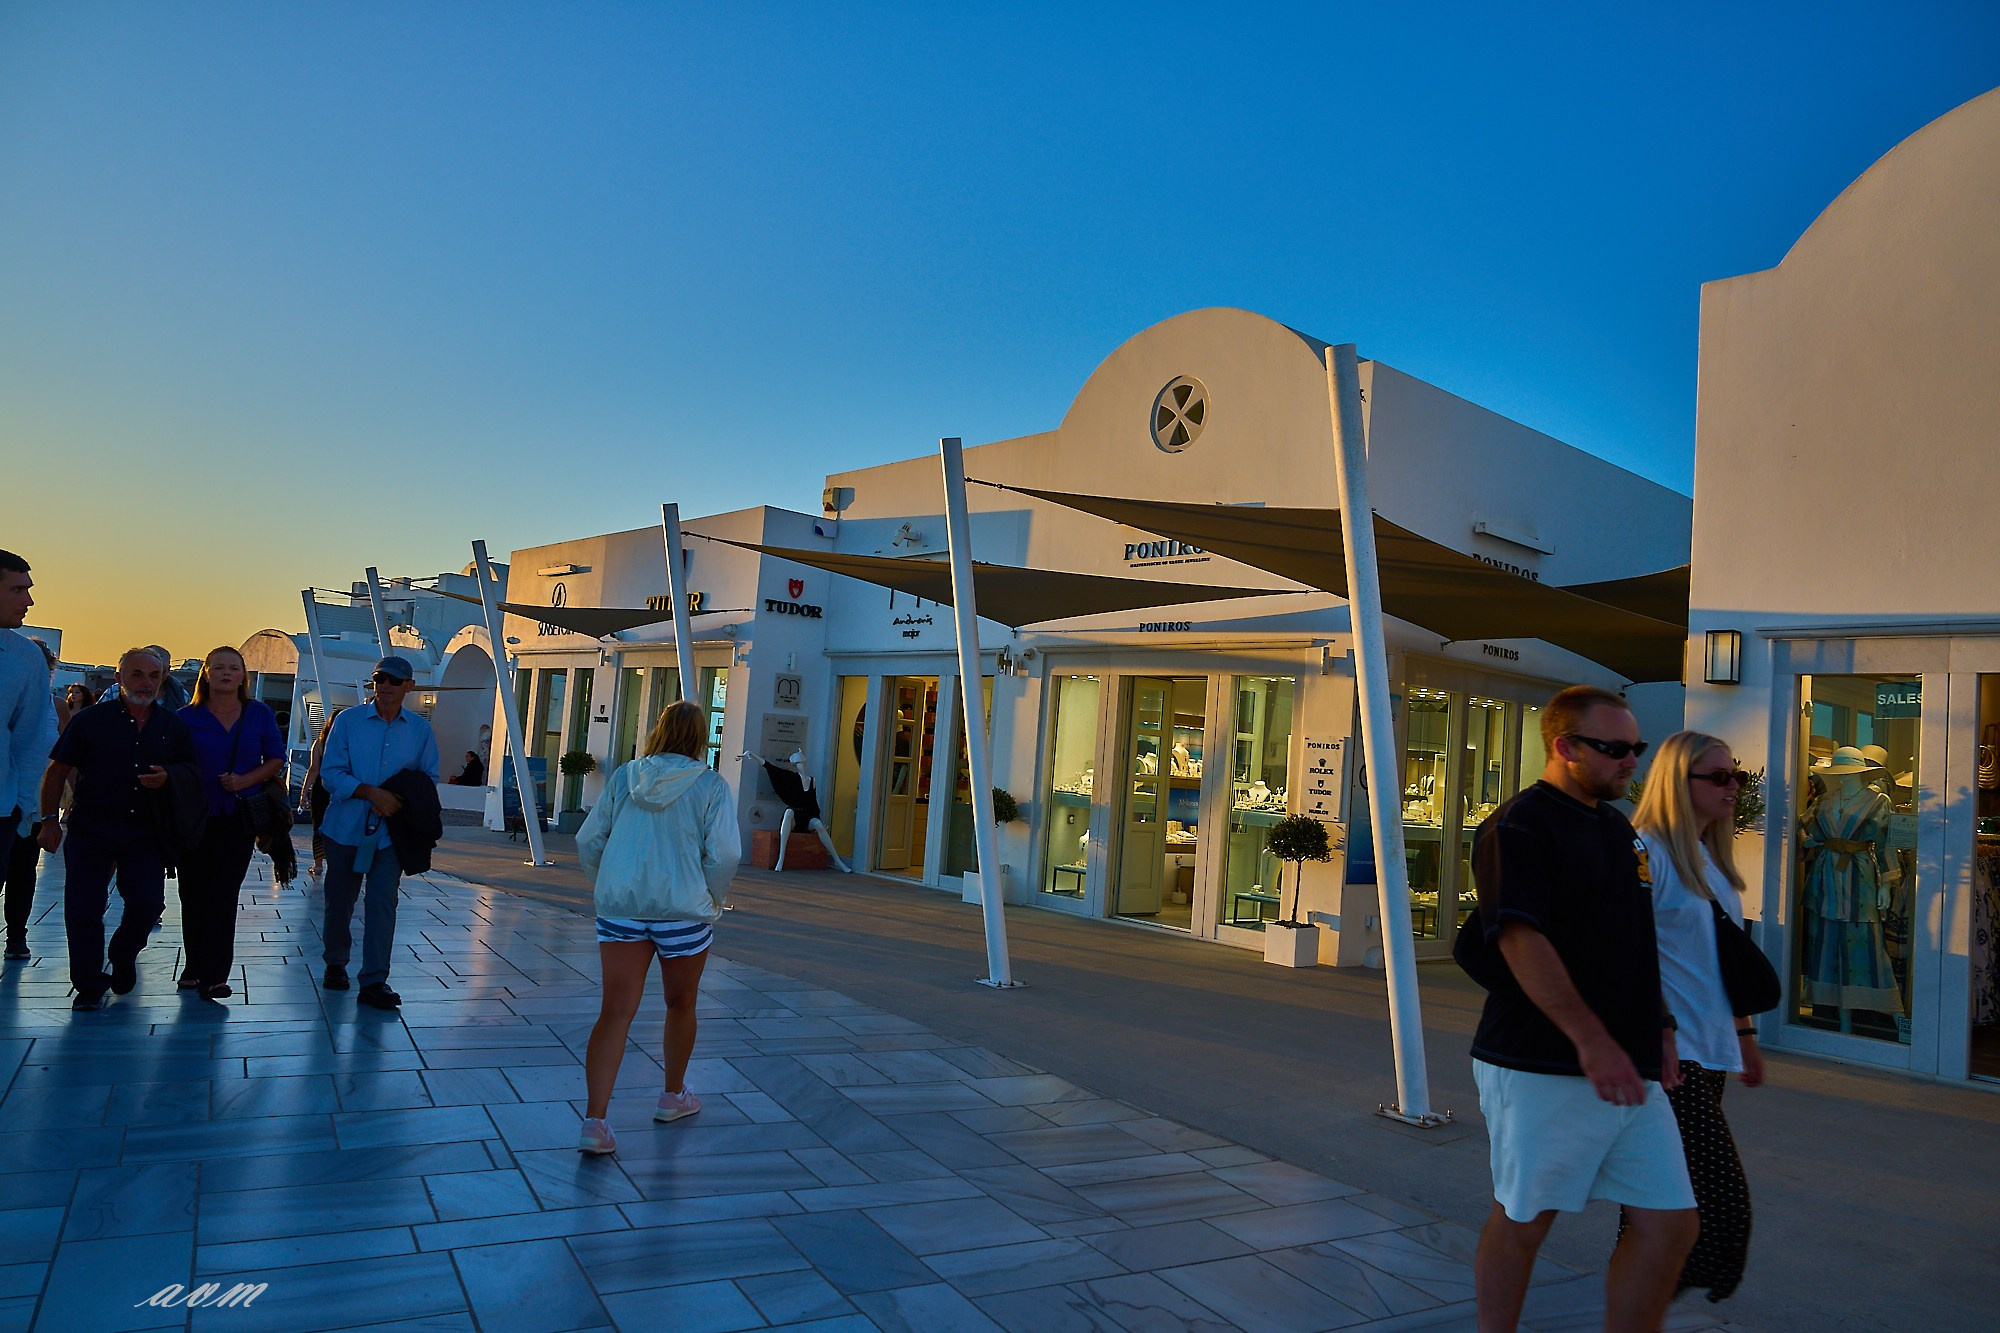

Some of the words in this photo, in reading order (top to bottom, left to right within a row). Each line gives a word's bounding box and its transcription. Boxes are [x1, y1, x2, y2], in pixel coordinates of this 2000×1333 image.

[1123, 539, 1204, 561] PONIR
[645, 591, 704, 611] TUR
[765, 599, 823, 619] TUDOR
[892, 613, 933, 626] Andronis
[1138, 621, 1193, 633] PONIROS
[1482, 643, 1519, 661] PONIROS
[1877, 692, 1923, 705] SALES
[1307, 742, 1341, 750] PONIROS
[1309, 767, 1334, 776] ROLEX
[1308, 788, 1332, 796] TUDOR
